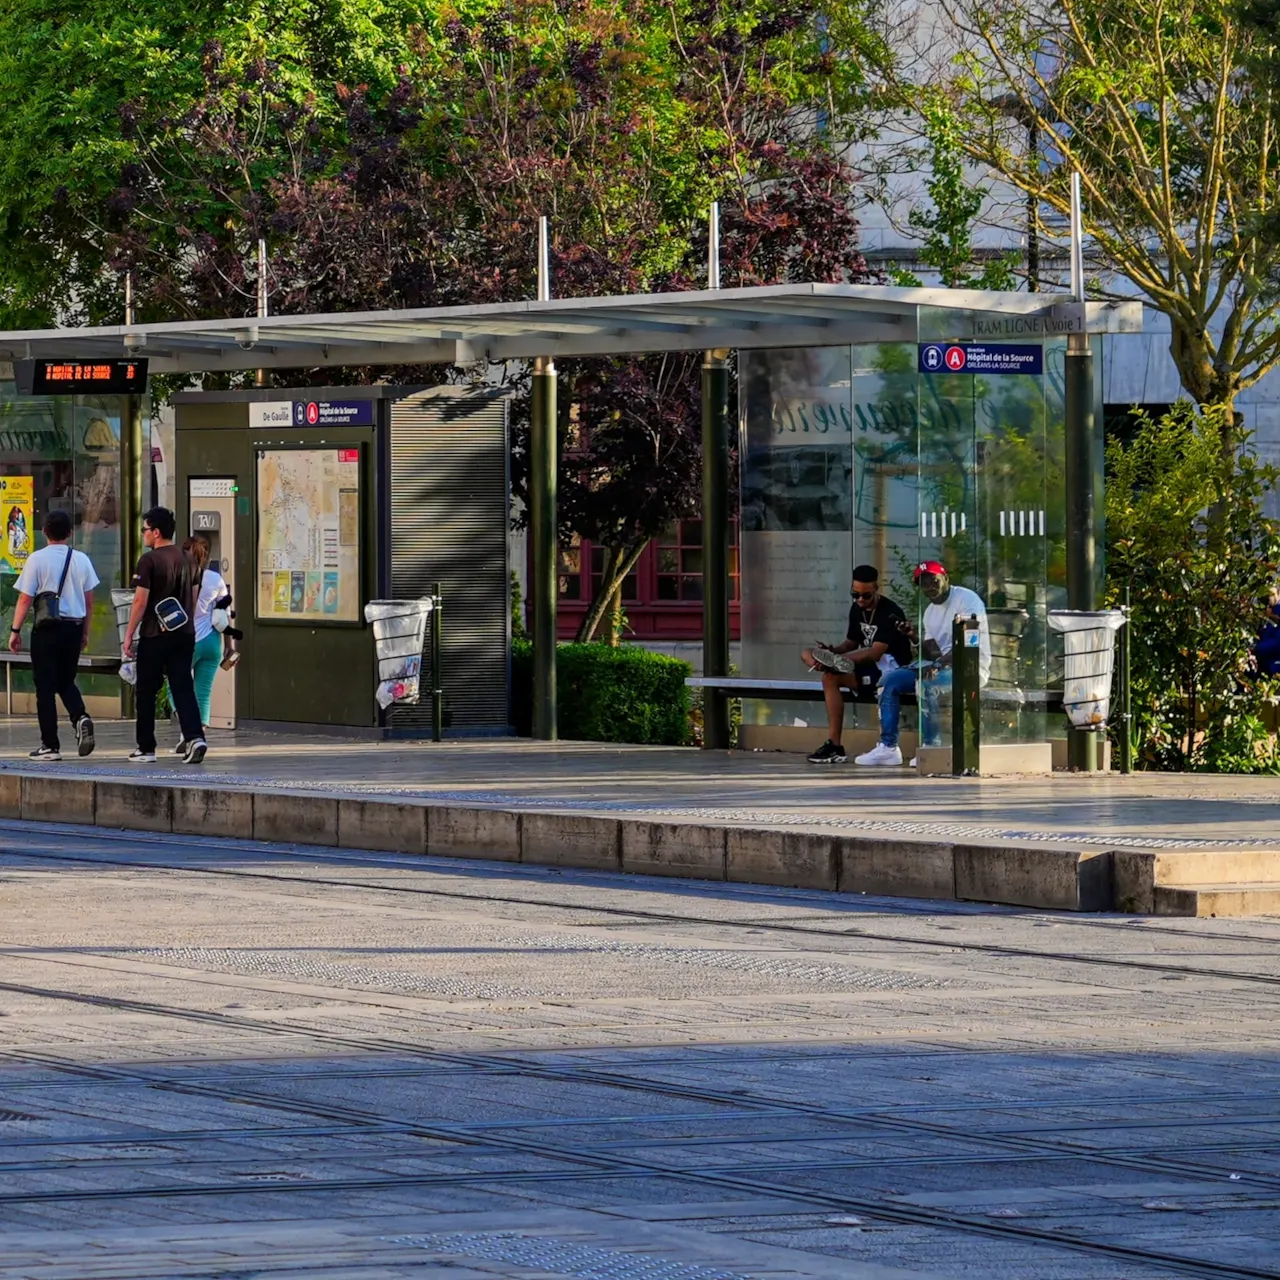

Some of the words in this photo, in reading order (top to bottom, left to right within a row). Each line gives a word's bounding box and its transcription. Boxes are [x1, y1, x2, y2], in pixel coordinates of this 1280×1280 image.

[972, 320, 1002, 335] TRAM
[1005, 318, 1039, 333] LIGNE
[1052, 316, 1073, 331] voie
[1076, 316, 1082, 330] 1
[950, 351, 961, 366] A
[967, 353, 993, 362] Hôpital
[993, 353, 1002, 361] de
[1010, 354, 1034, 362] Source
[263, 412, 270, 421] De
[271, 411, 289, 421] Gaulle
